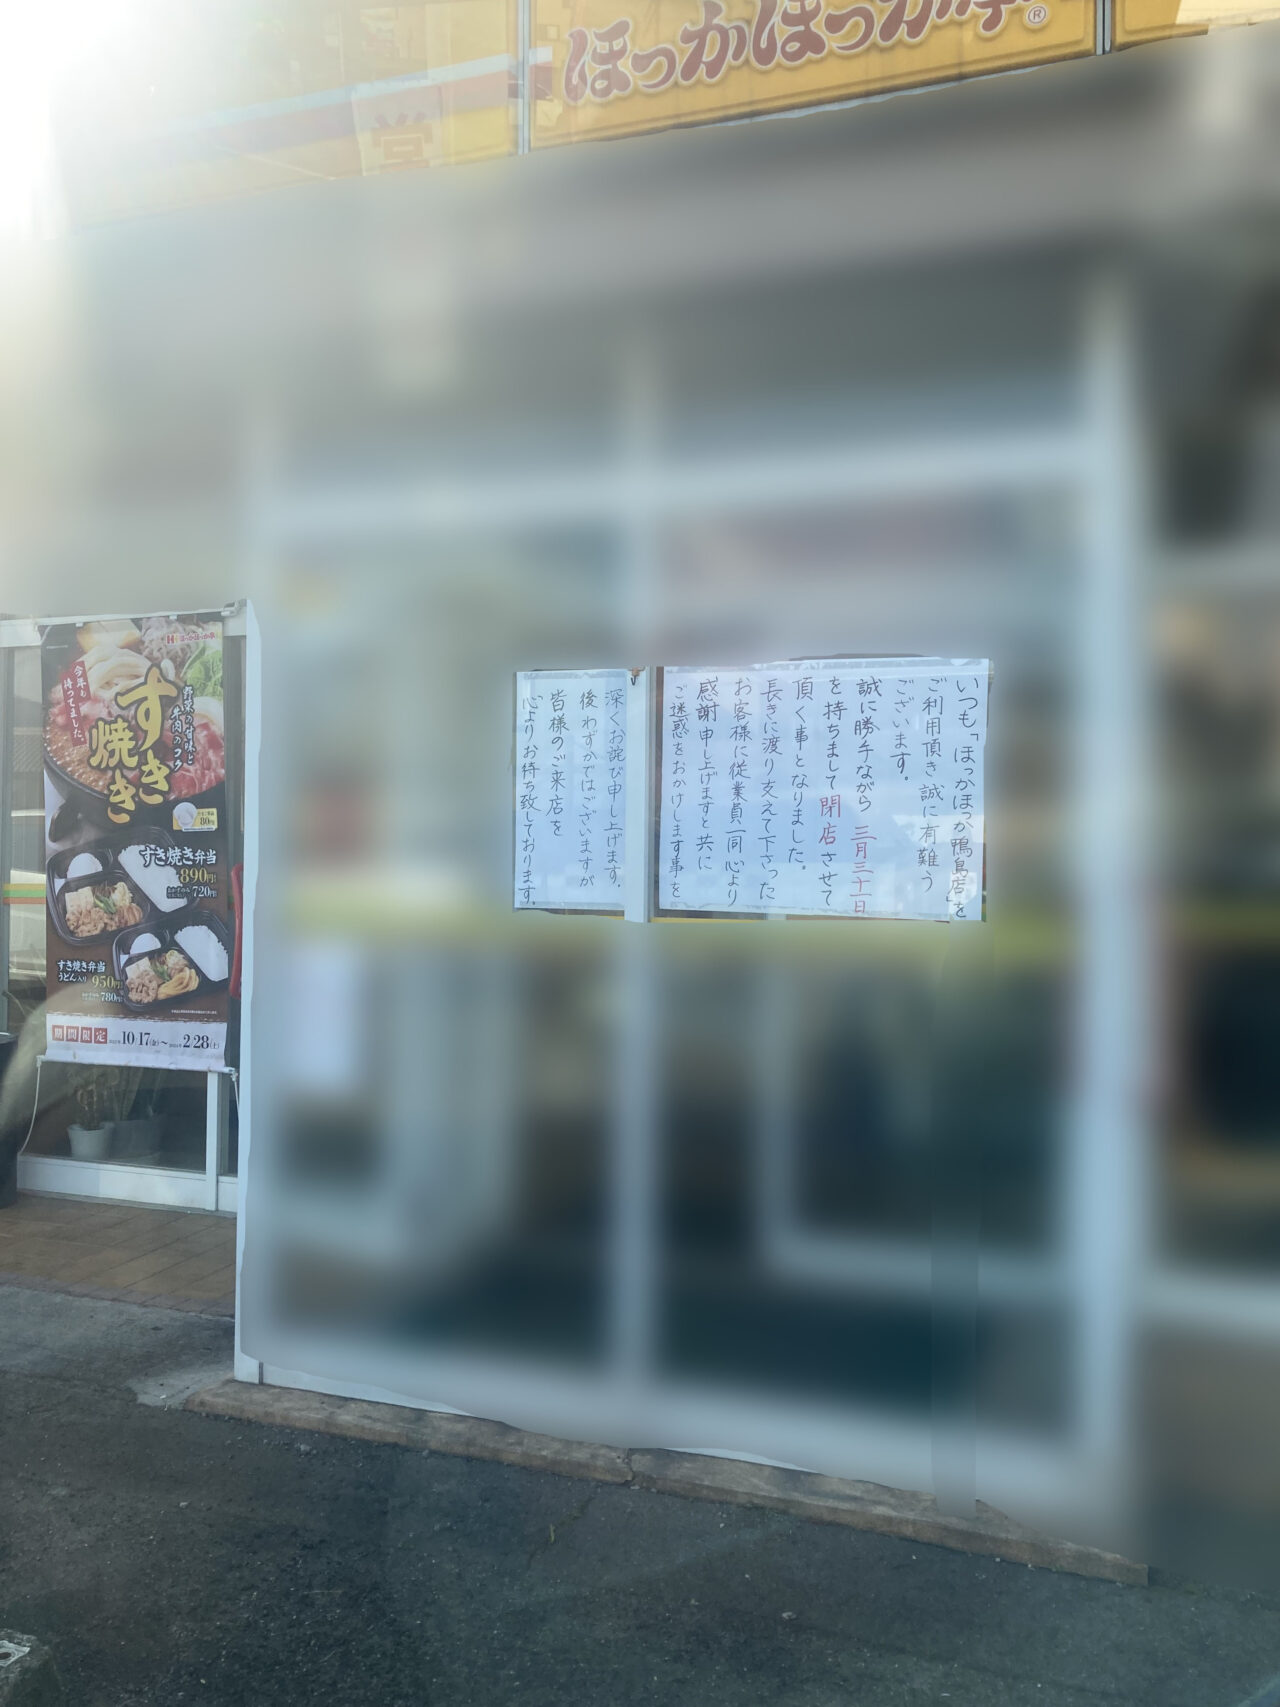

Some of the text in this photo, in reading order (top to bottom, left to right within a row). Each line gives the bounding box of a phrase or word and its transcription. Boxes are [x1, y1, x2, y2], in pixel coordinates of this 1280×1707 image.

[63, 678, 85, 742] 待ってました。
[73, 665, 87, 698] 今年も
[546, 688, 570, 837] 皆様のご来店を
[579, 689, 598, 887] 後わずかではございますが
[669, 684, 689, 898] ご迷惑をおかけします事を
[696, 676, 720, 870] 感謝申し上げますと共に
[758, 678, 783, 900] 長きに渡り支えて下さった
[140, 846, 216, 867] すき焼き弁当
[57, 959, 105, 973] すき焼き弁当
[58, 972, 87, 984] うどん入り
[53, 1026, 106, 1043] 期間限定
